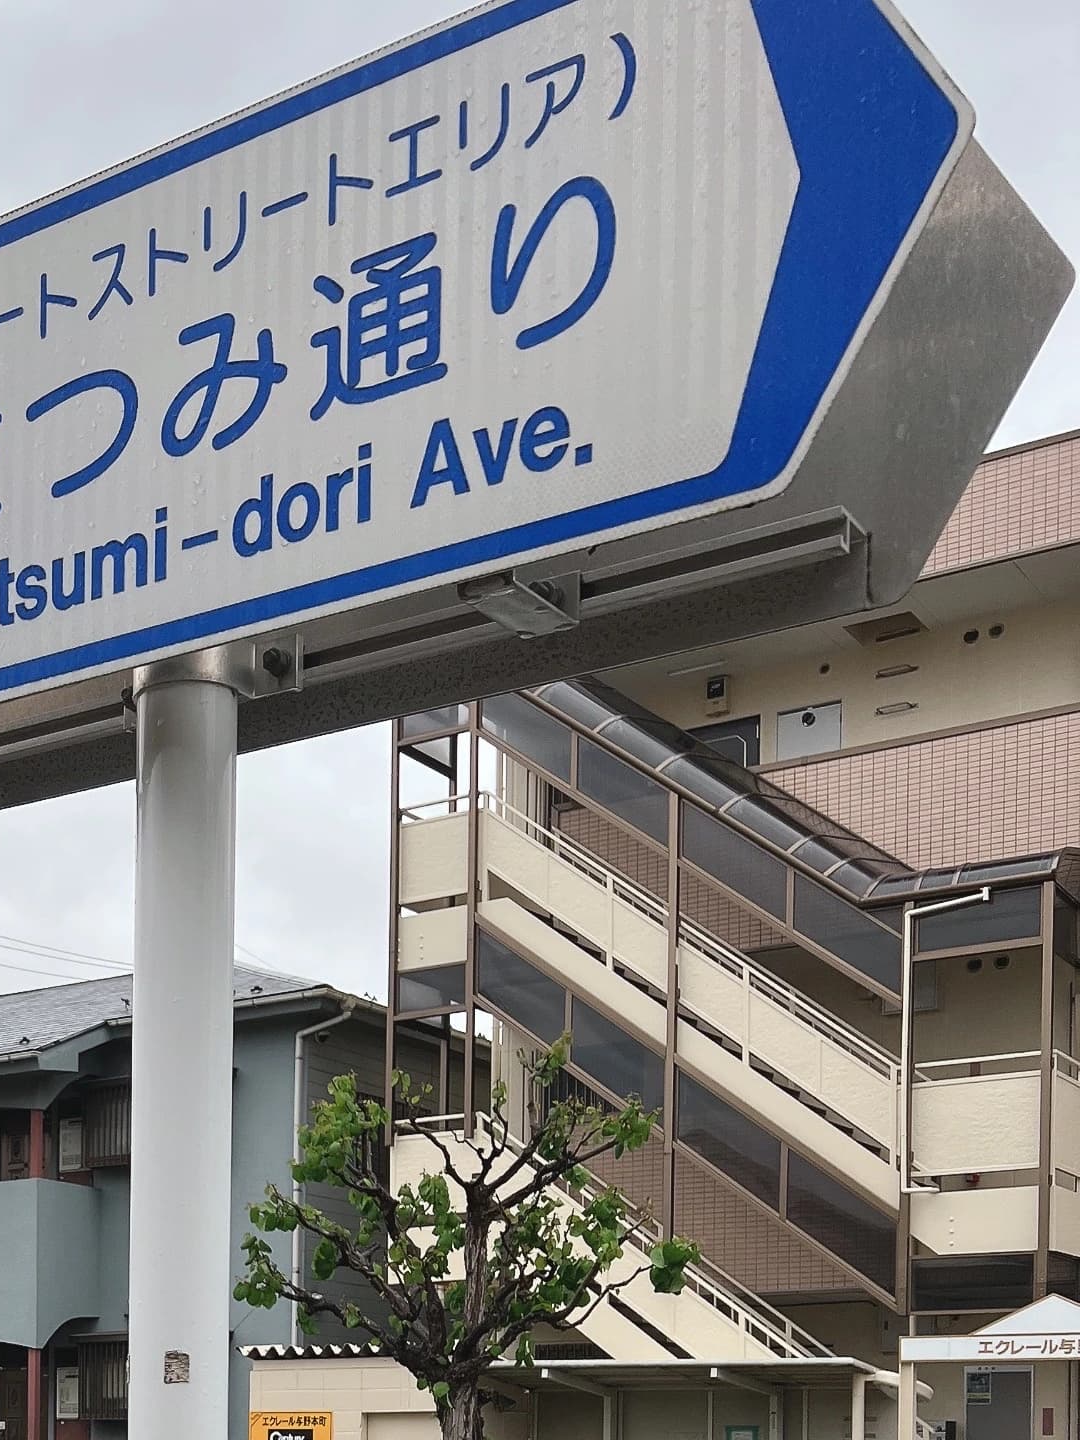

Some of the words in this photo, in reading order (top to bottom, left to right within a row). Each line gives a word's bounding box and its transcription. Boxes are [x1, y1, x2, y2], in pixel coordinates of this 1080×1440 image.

[410, 405, 593, 508] Ave.
[978, 1339, 1080, 1355] エクレール与
[262, 1415, 327, 1427] エクレール与野本町
